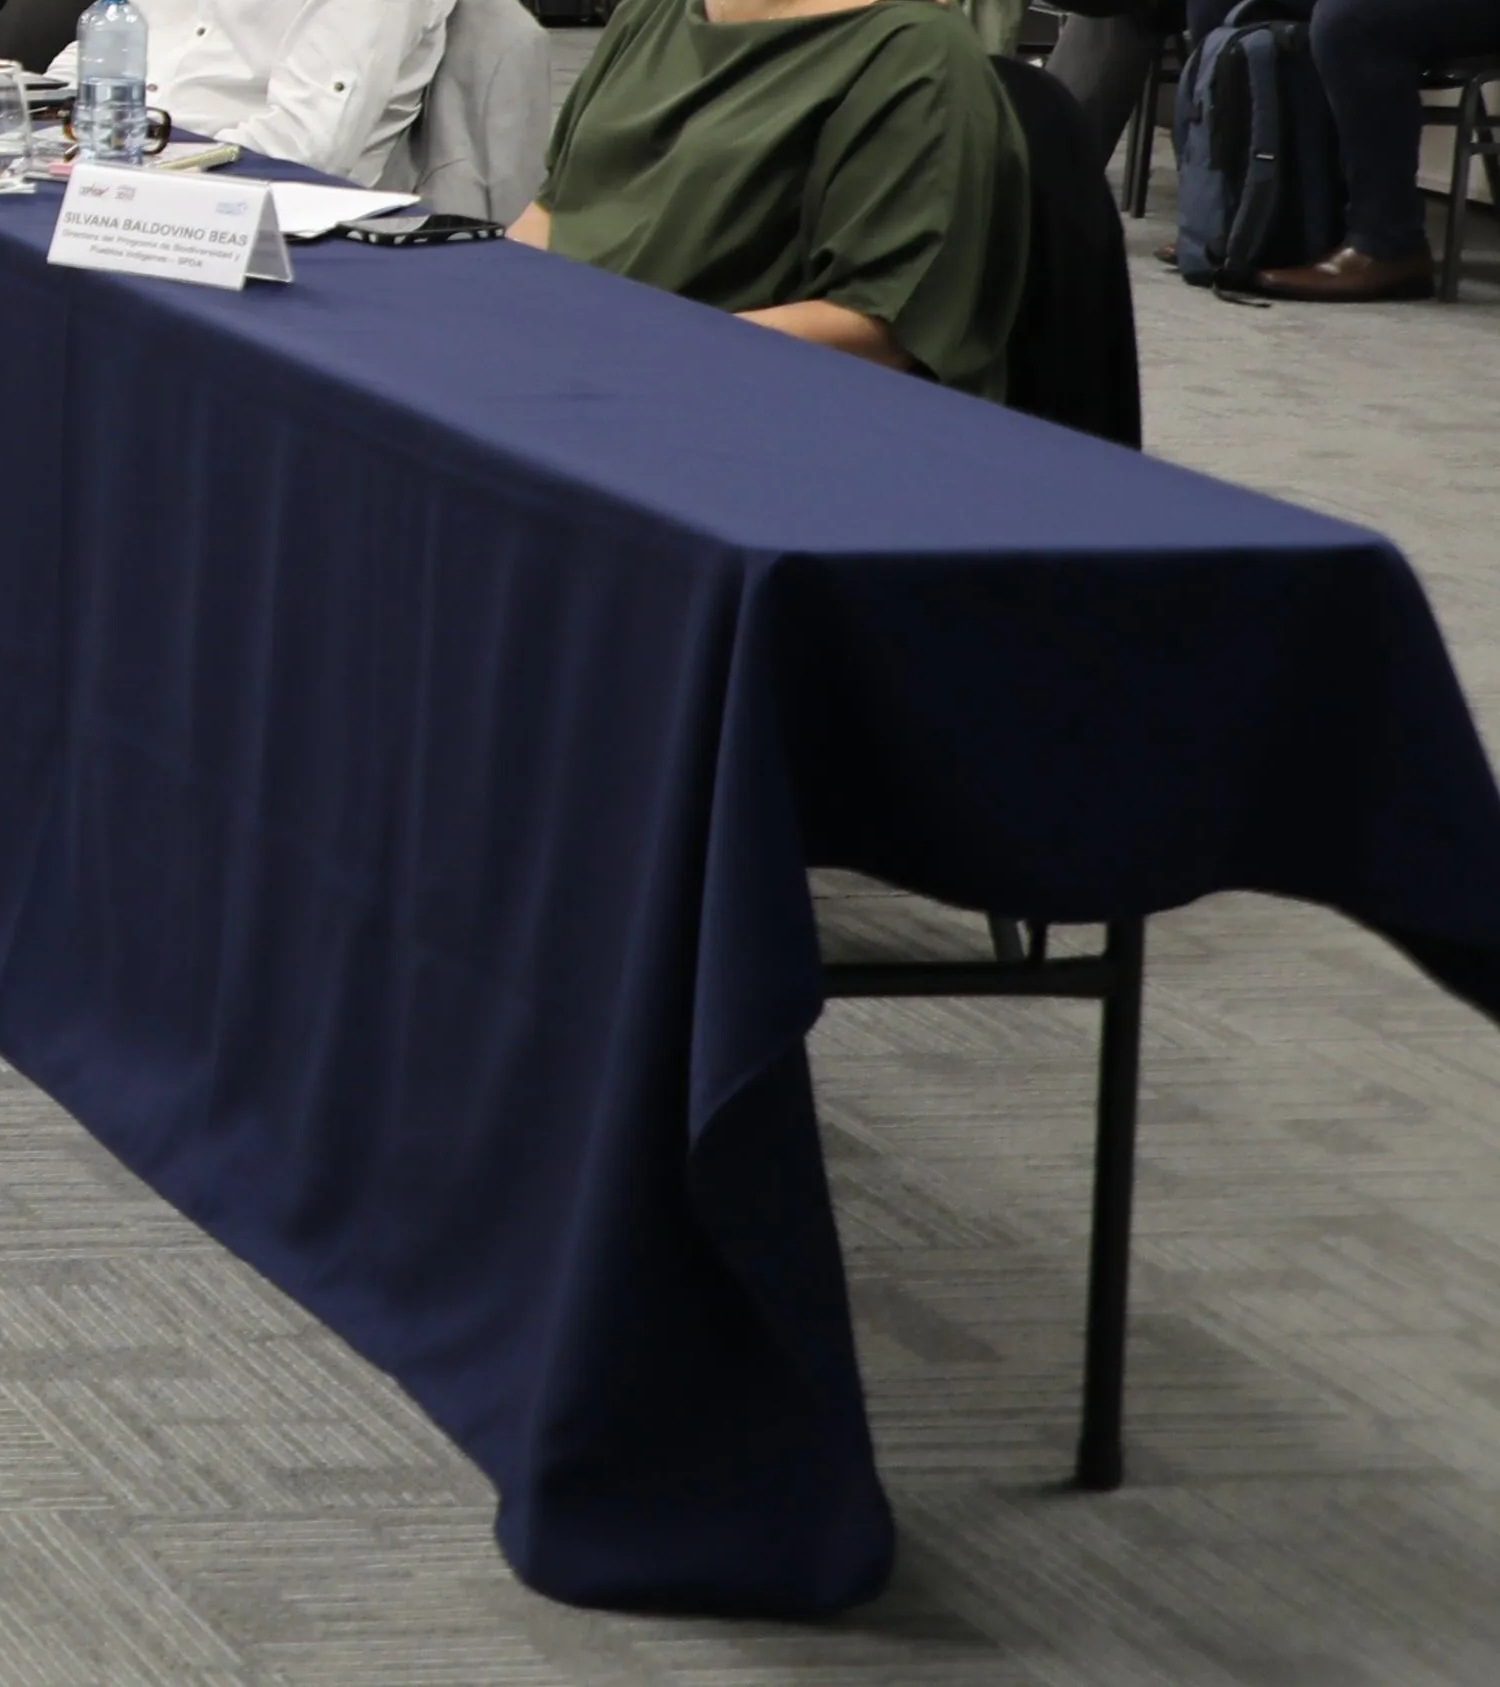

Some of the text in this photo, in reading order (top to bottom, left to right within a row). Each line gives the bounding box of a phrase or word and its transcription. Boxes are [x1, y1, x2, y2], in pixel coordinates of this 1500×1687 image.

[63, 211, 248, 247] SILVANA BALDOVINO BEAS
